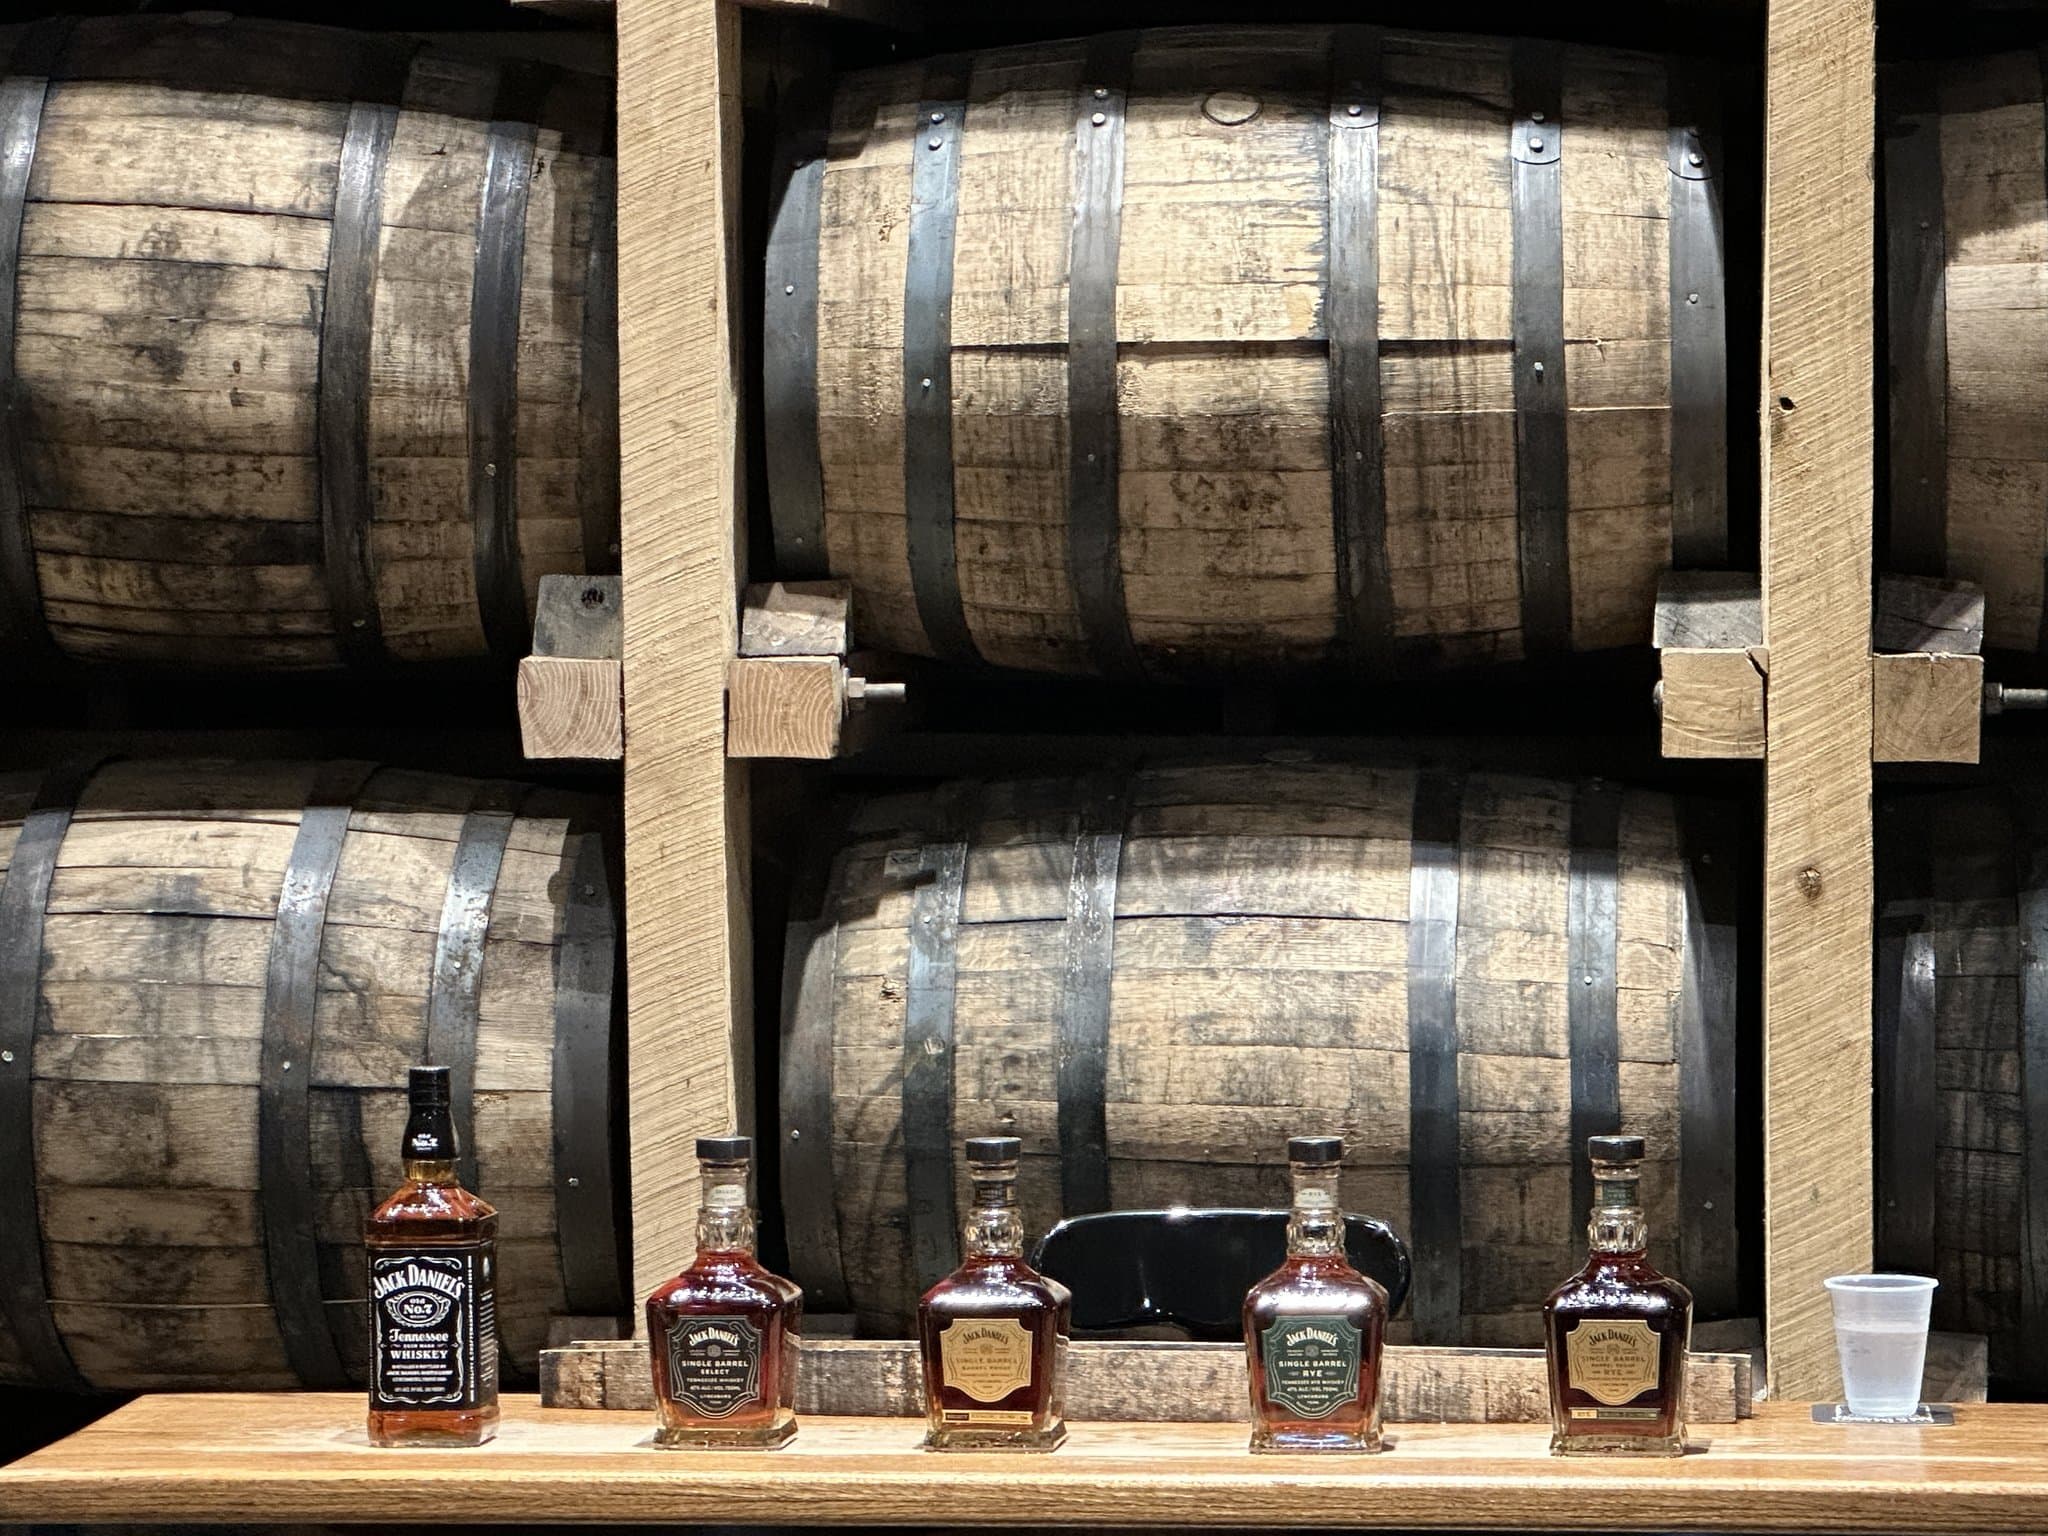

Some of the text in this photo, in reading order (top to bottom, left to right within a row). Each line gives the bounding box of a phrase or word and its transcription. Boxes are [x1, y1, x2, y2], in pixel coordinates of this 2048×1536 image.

[373, 1264, 466, 1300] JACK DANIEL'S
[403, 1304, 433, 1315] No.7
[388, 1328, 449, 1342] Tennessee
[688, 1326, 740, 1347] JACK DANIEL'S
[963, 1331, 980, 1344] JACK
[1286, 1327, 1339, 1347] JACK DANIEL'S
[1589, 1332, 1607, 1346] JACK
[390, 1350, 449, 1359] WHISKEY
